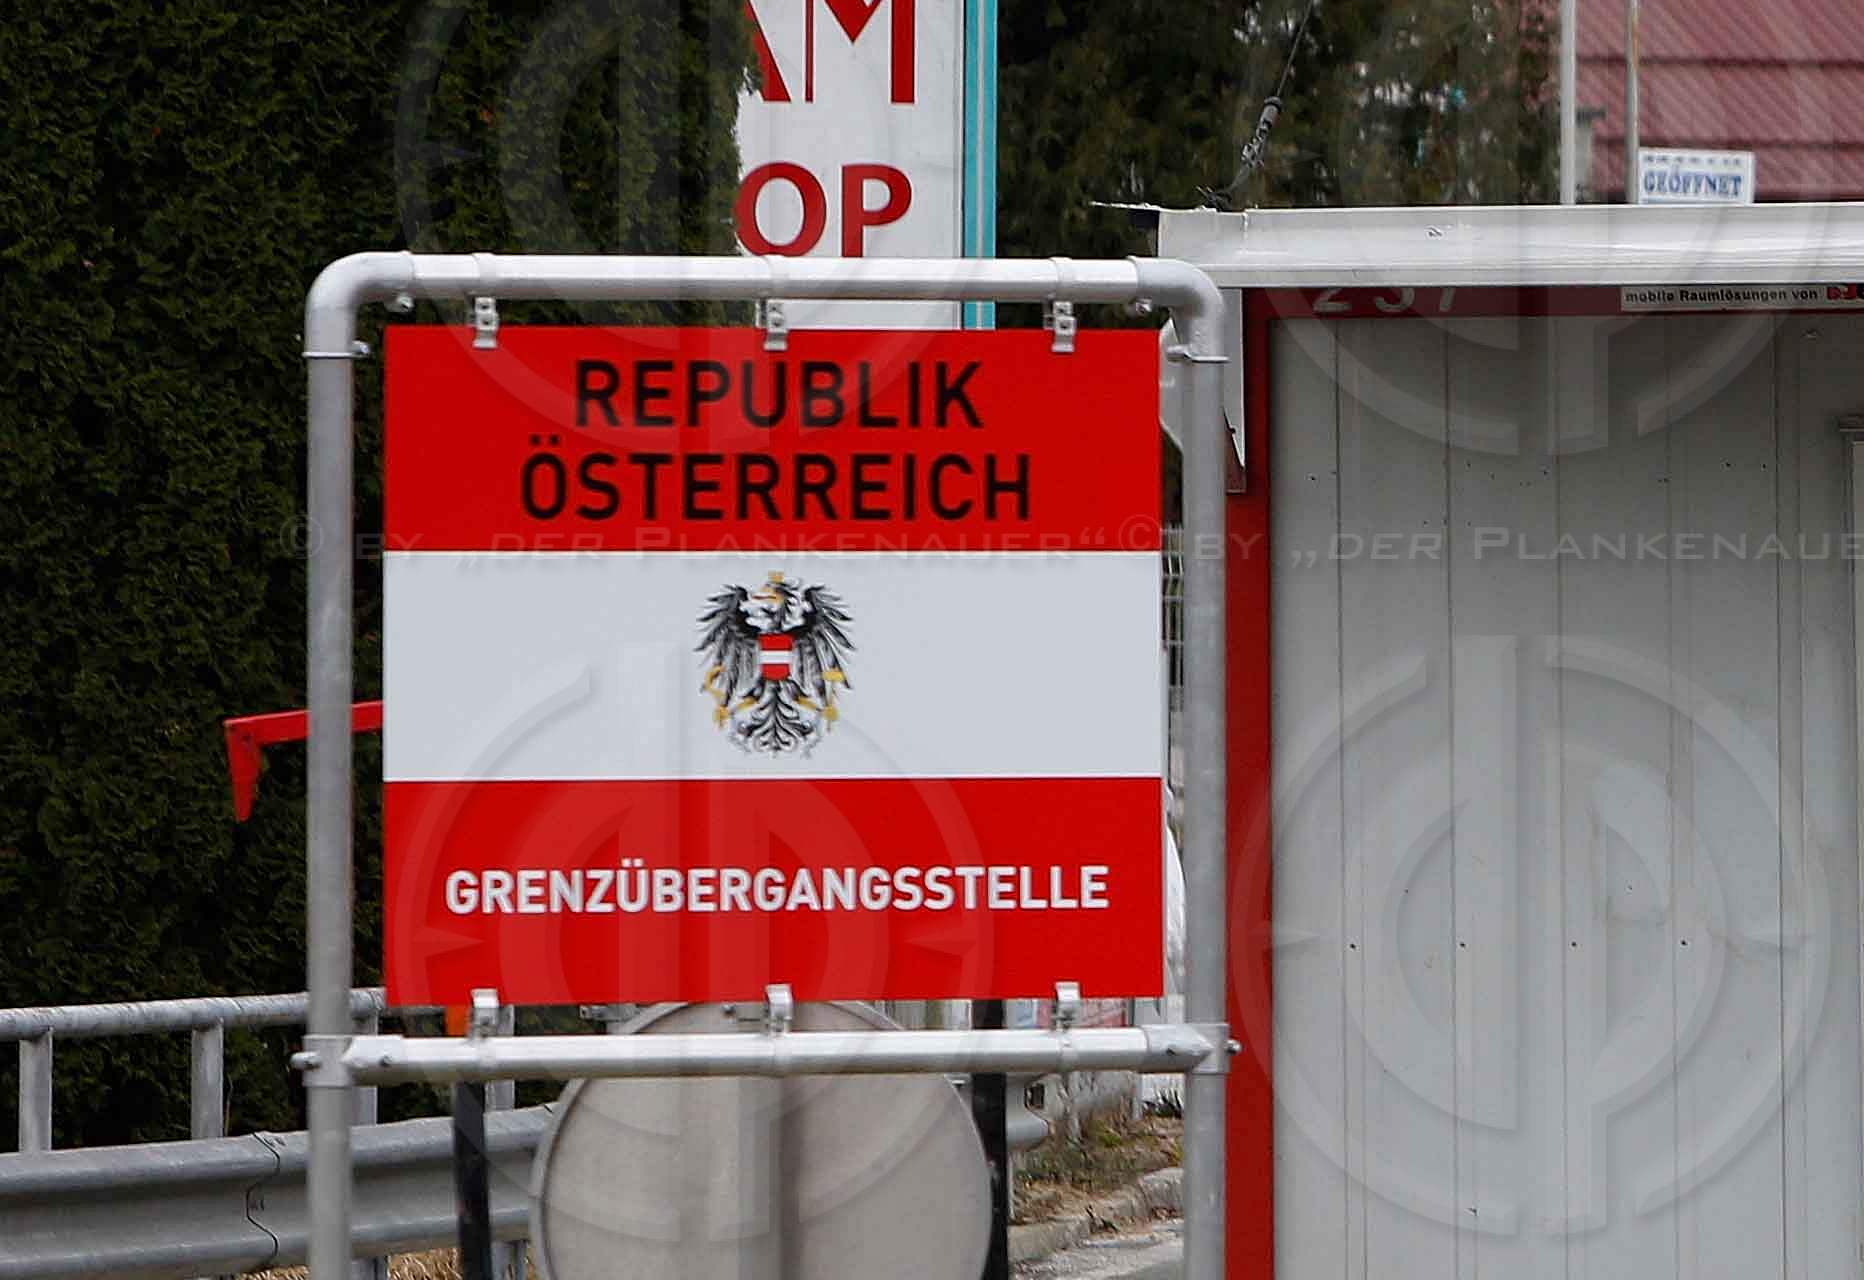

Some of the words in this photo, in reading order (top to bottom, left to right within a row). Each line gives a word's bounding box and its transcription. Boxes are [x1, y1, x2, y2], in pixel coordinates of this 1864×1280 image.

[1644, 165, 1742, 197] GEÖFFNET
[1626, 289, 1674, 303] mobile
[1680, 287, 1787, 304] Raumlösungen
[1792, 291, 1818, 301] von
[575, 361, 982, 428] REPUBLIK
[522, 435, 1031, 519] ÖSTERREICH
[445, 859, 1108, 914] GRENZÜBERGANGSSTELLE
